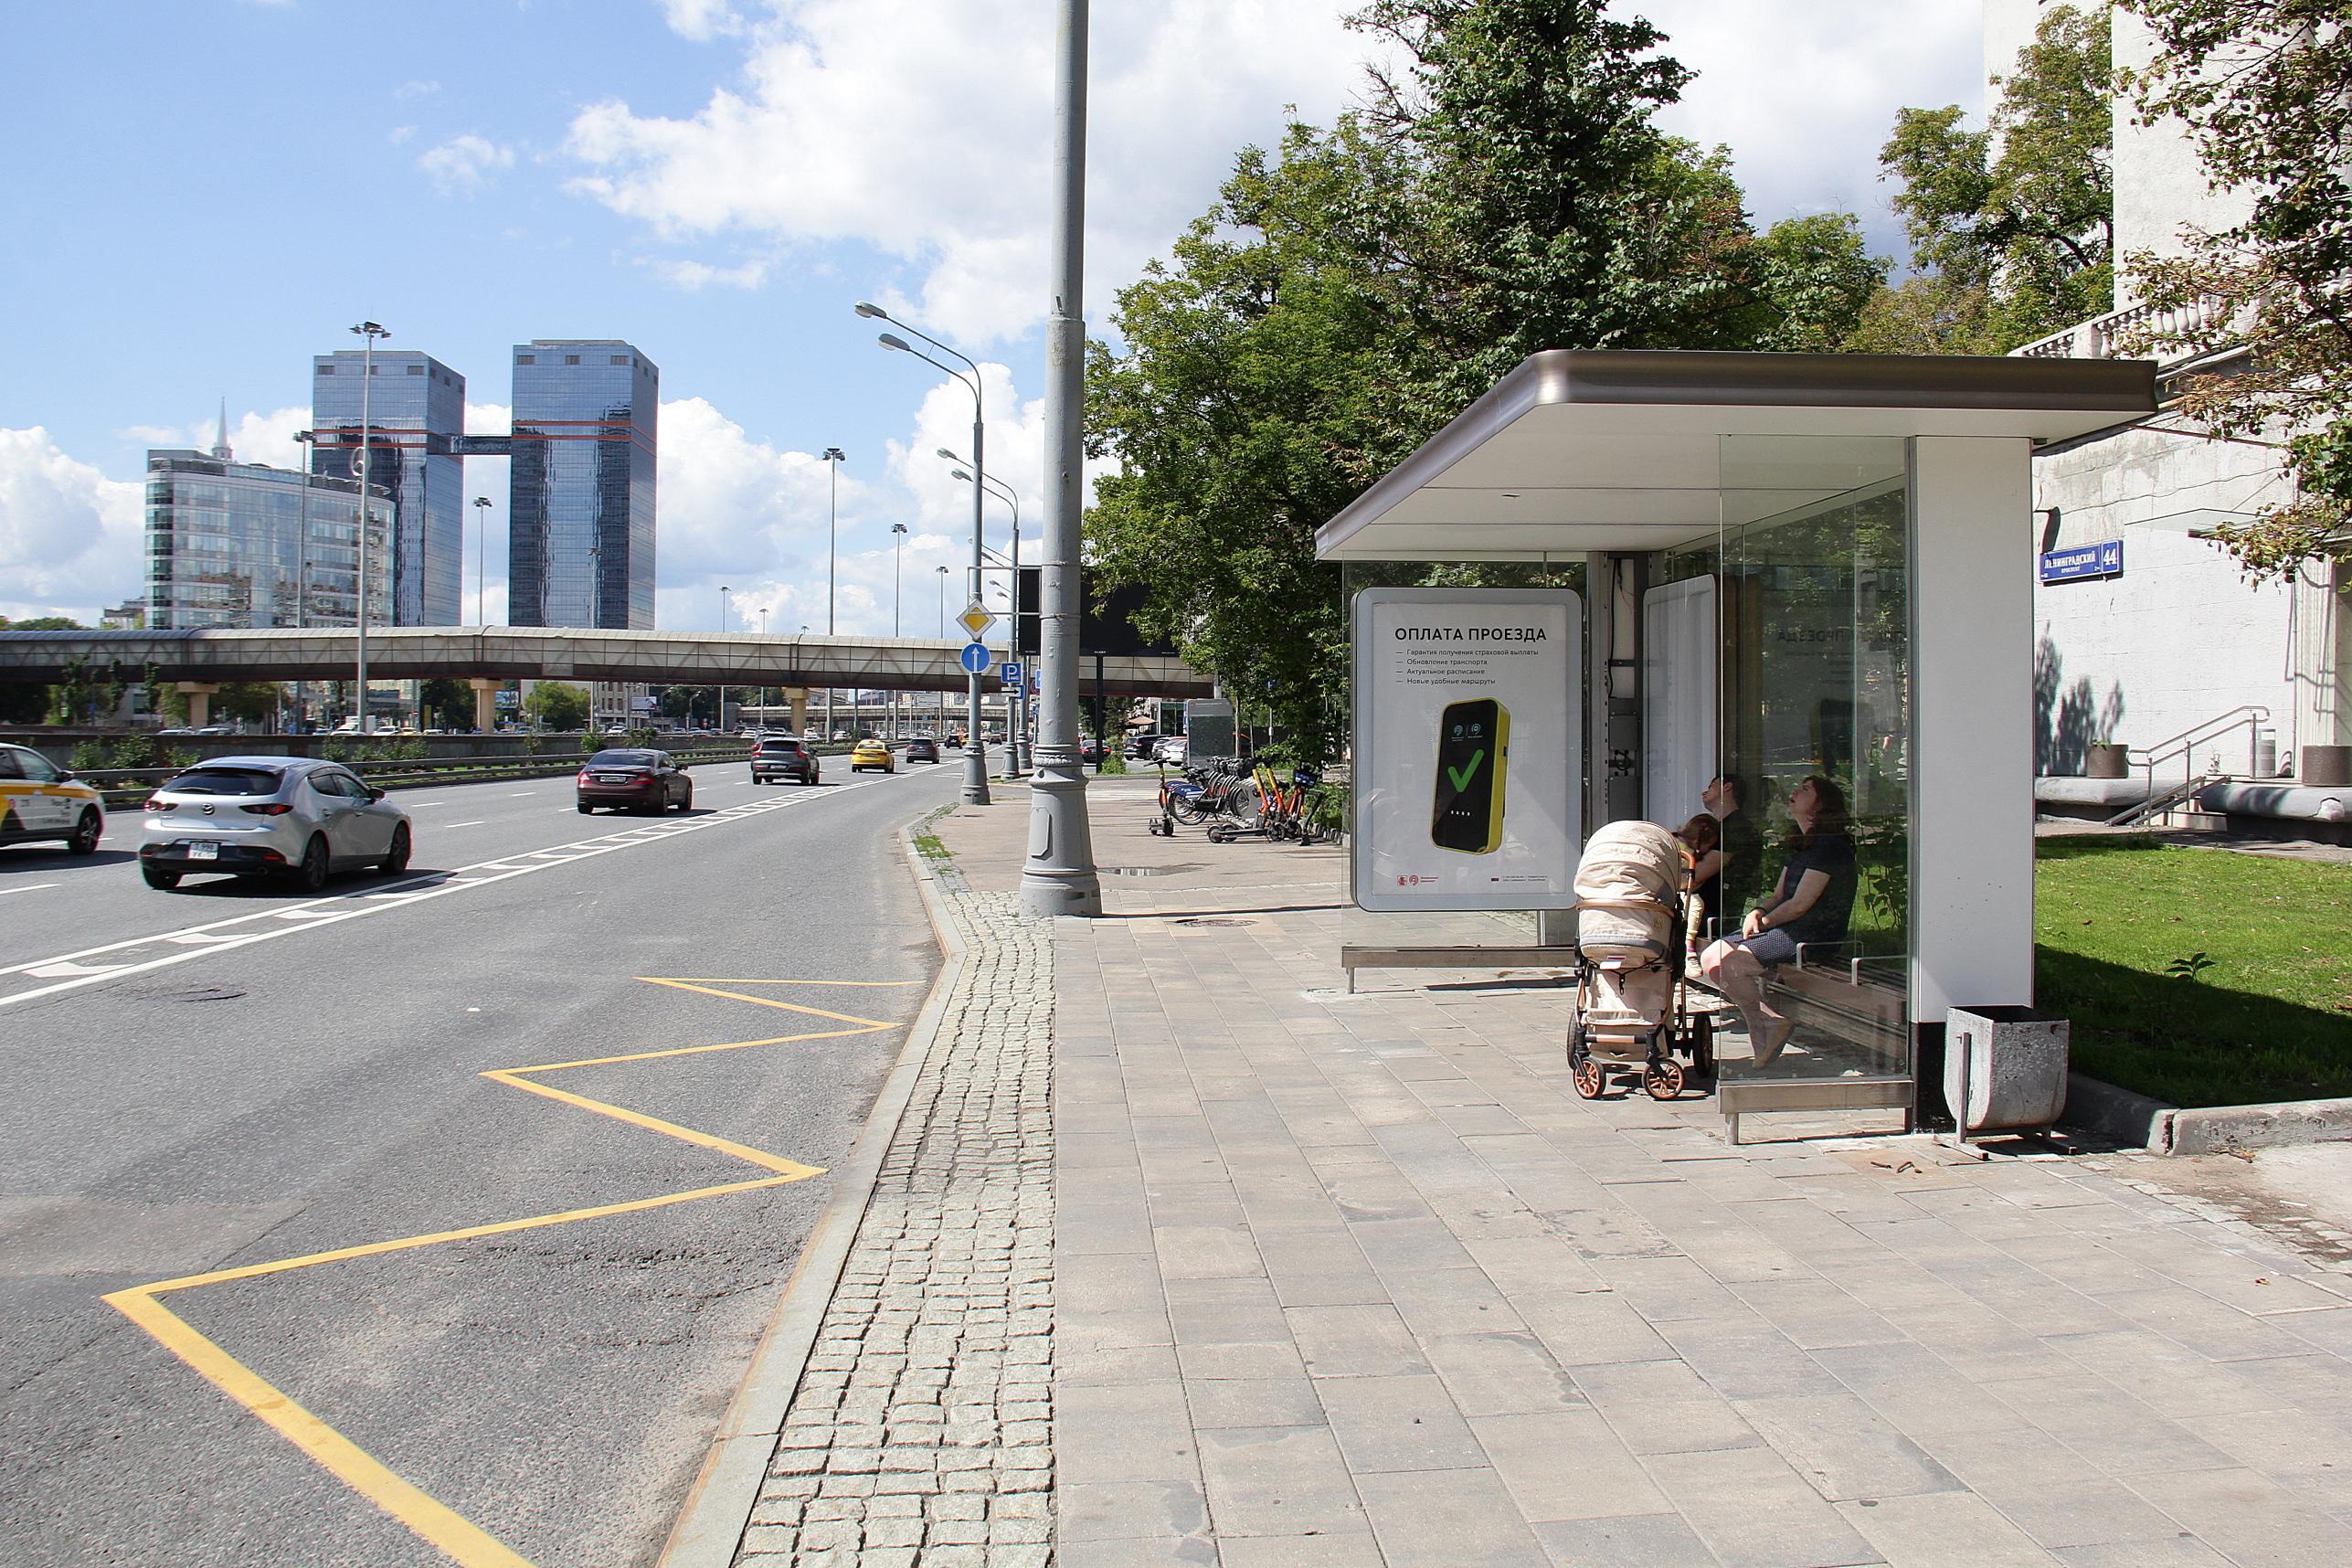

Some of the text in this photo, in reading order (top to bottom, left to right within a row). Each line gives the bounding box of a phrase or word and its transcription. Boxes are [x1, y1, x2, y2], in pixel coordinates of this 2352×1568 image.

[2044, 551, 2096, 568] ЛЕНИНГРАДСКИЙ
[2103, 549, 2117, 565] 44
[1394, 628, 1547, 642] ОПЛАТА ПРОЕЗДА
[1008, 665, 1017, 681] P
